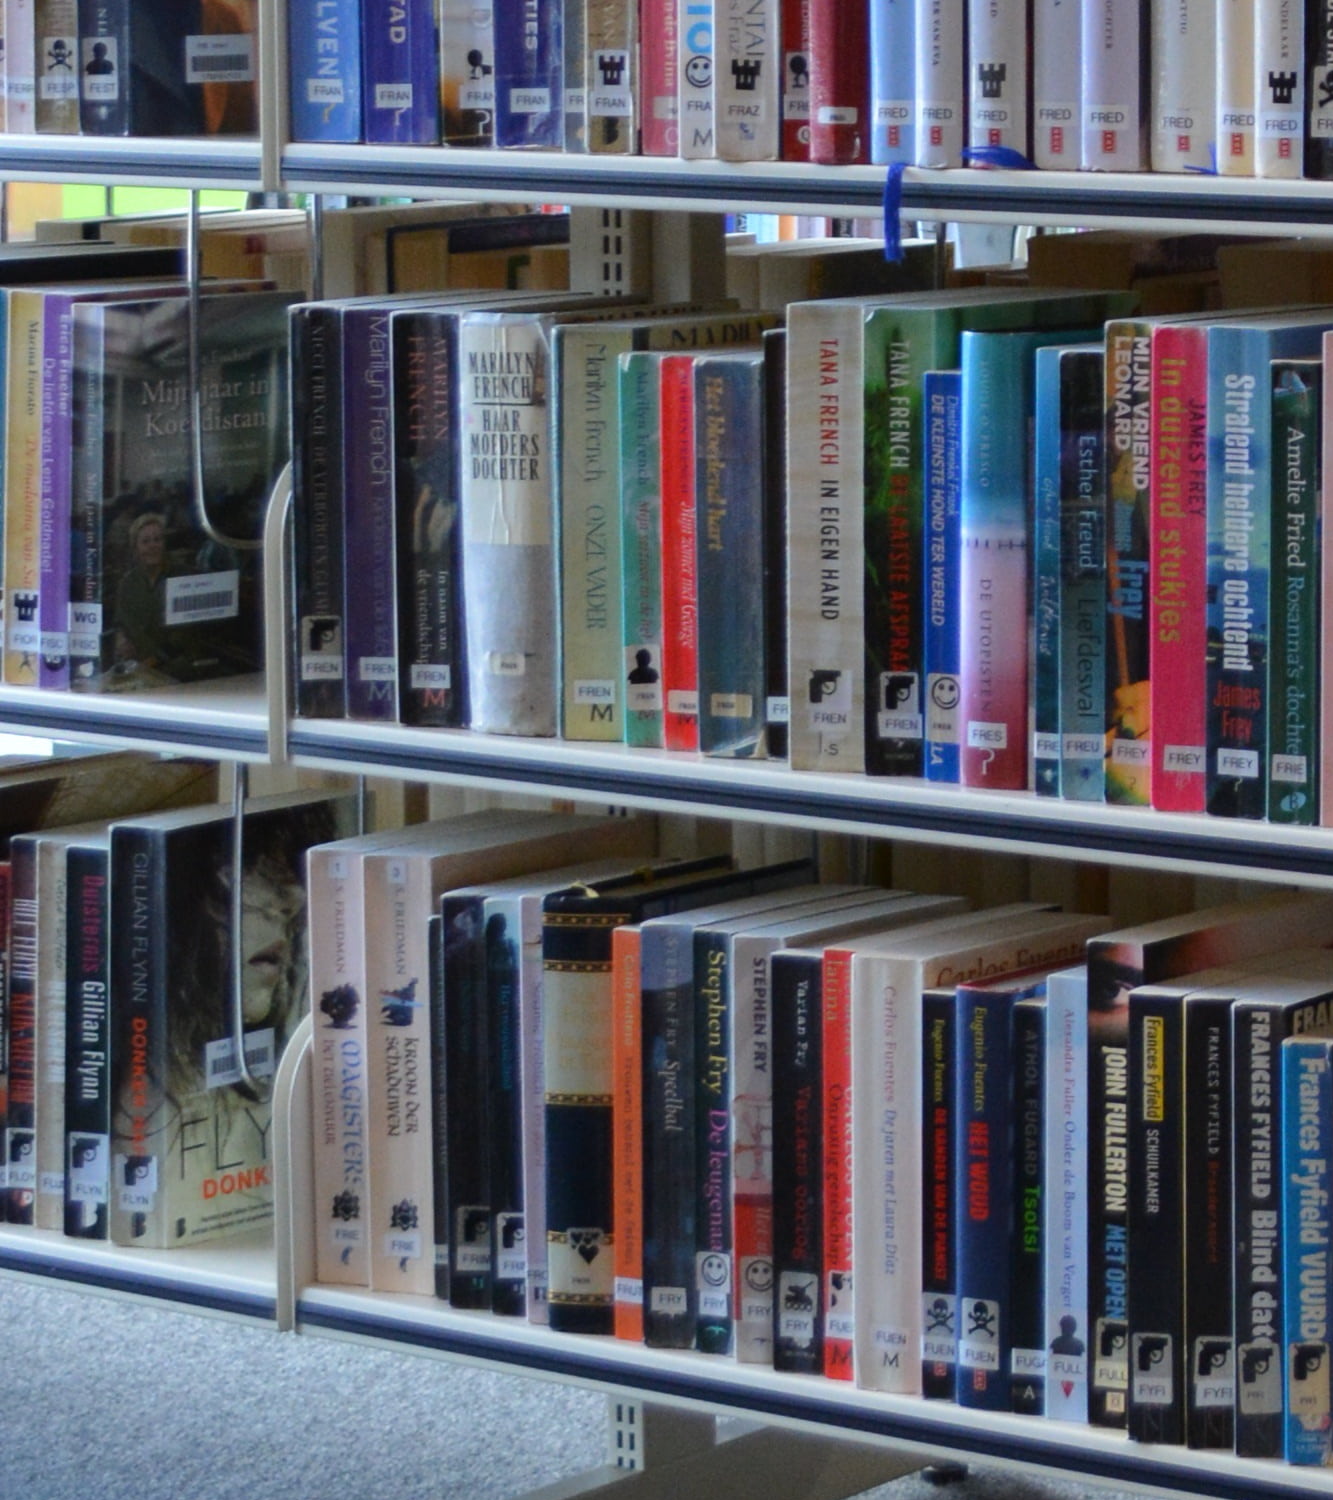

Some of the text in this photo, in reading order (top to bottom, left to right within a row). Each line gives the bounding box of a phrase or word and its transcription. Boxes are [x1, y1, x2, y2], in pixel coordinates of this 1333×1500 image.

[471, 434, 539, 455] MOEDERS
[481, 410, 521, 431] HAAR
[1113, 337, 1130, 451] LEONARD
[1132, 337, 1150, 489] MIJN VRIEND
[472, 459, 539, 480] DOCHTER
[819, 339, 839, 620] TANA FRENCH IN EIGEN HAND
[1078, 436, 1097, 568] Esther Freud
[1159, 358, 1187, 643] in duizend stukjes
[1223, 374, 1256, 671] Stralend heldere ochtend
[1288, 429, 1305, 568] Amelie Fried
[1223, 757, 1253, 769] FREY
[82, 982, 106, 1100] Gillian Flynn
[753, 958, 767, 1073] STEPHEN FRY
[1143, 1018, 1161, 1120] Frances Fyfield
[1103, 1046, 1127, 1212] JOHN FULLERTON
[1252, 1012, 1271, 1198] FRANCES FYFIELD
[1292, 1058, 1326, 1247] Frances Fyfield
[1146, 1130, 1160, 1214] SCHUILKAMER
[1253, 1210, 1277, 1283] Blind
